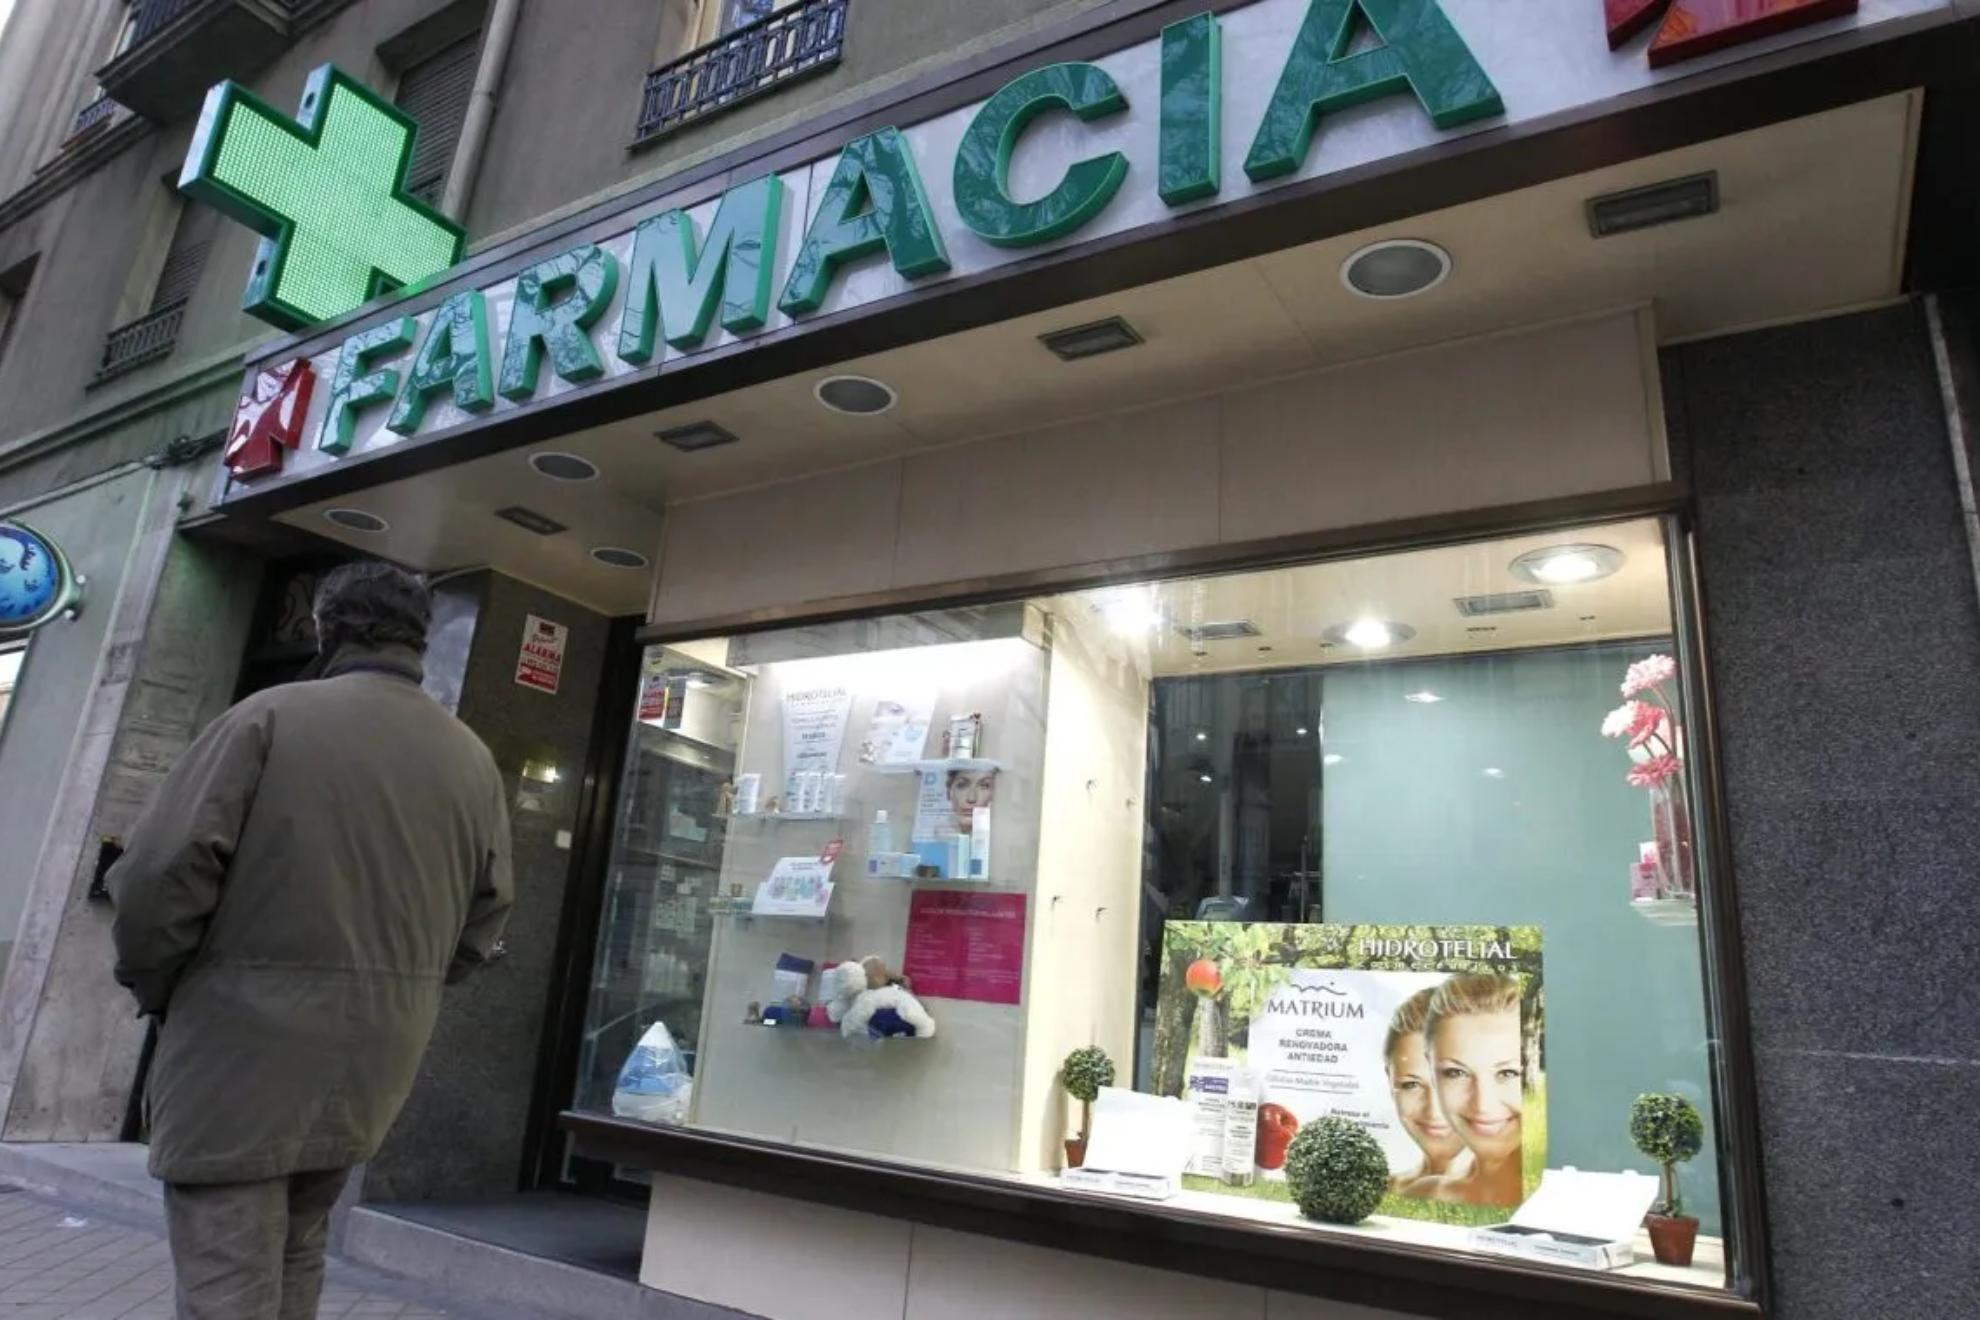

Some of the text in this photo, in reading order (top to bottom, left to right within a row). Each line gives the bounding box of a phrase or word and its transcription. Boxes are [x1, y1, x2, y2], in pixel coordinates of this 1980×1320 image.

[319, 0, 1505, 456] FARMACIA
[1358, 937, 1518, 961] HIDROTELIAL
[1267, 999, 1365, 1020] MATRIUM
[1295, 1028, 1332, 1039] CREMA
[1278, 1038, 1348, 1052] RENOVADORA
[1287, 1052, 1338, 1064] ANTIEDAD
